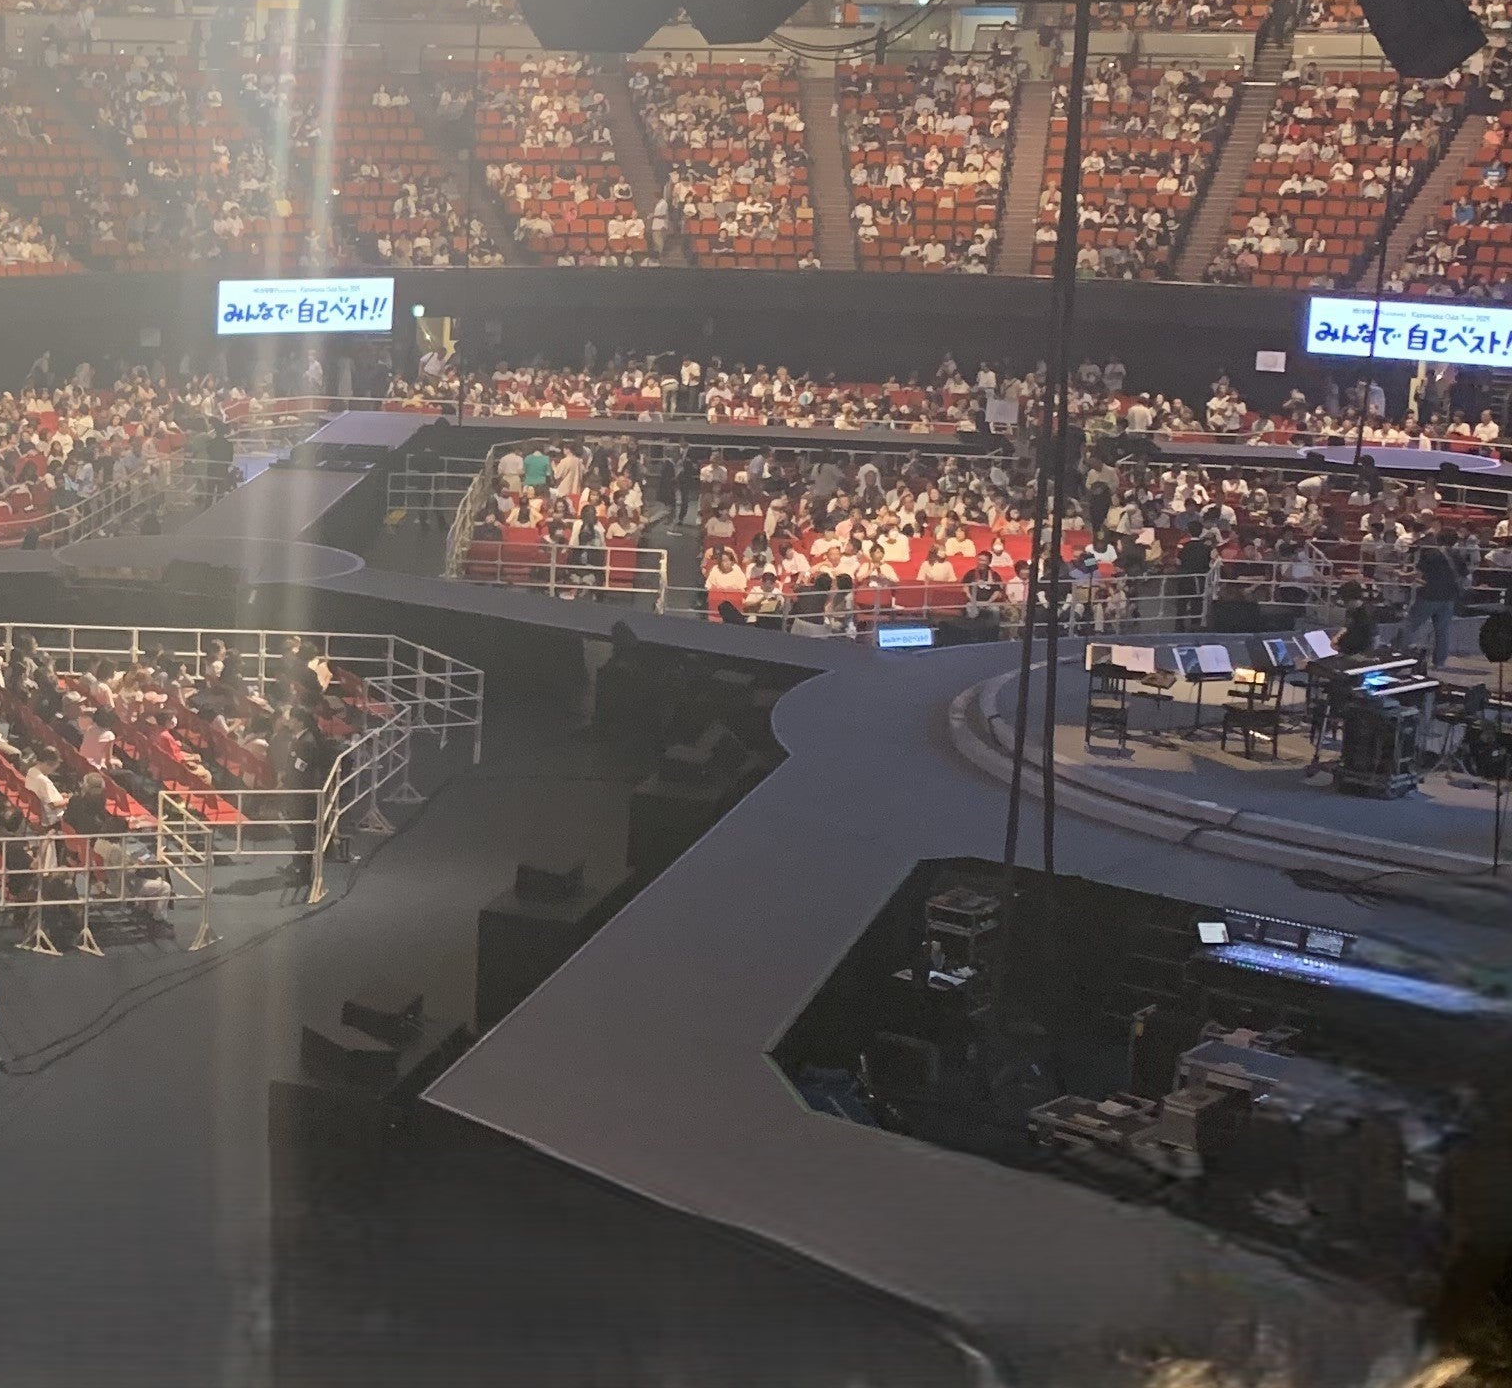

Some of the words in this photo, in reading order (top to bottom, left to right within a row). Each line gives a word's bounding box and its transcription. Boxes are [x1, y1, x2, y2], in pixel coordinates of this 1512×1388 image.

[223, 301, 294, 323] みんなで
[298, 297, 388, 324] 自己ベスト!!
[1315, 321, 1402, 346] みんなで
